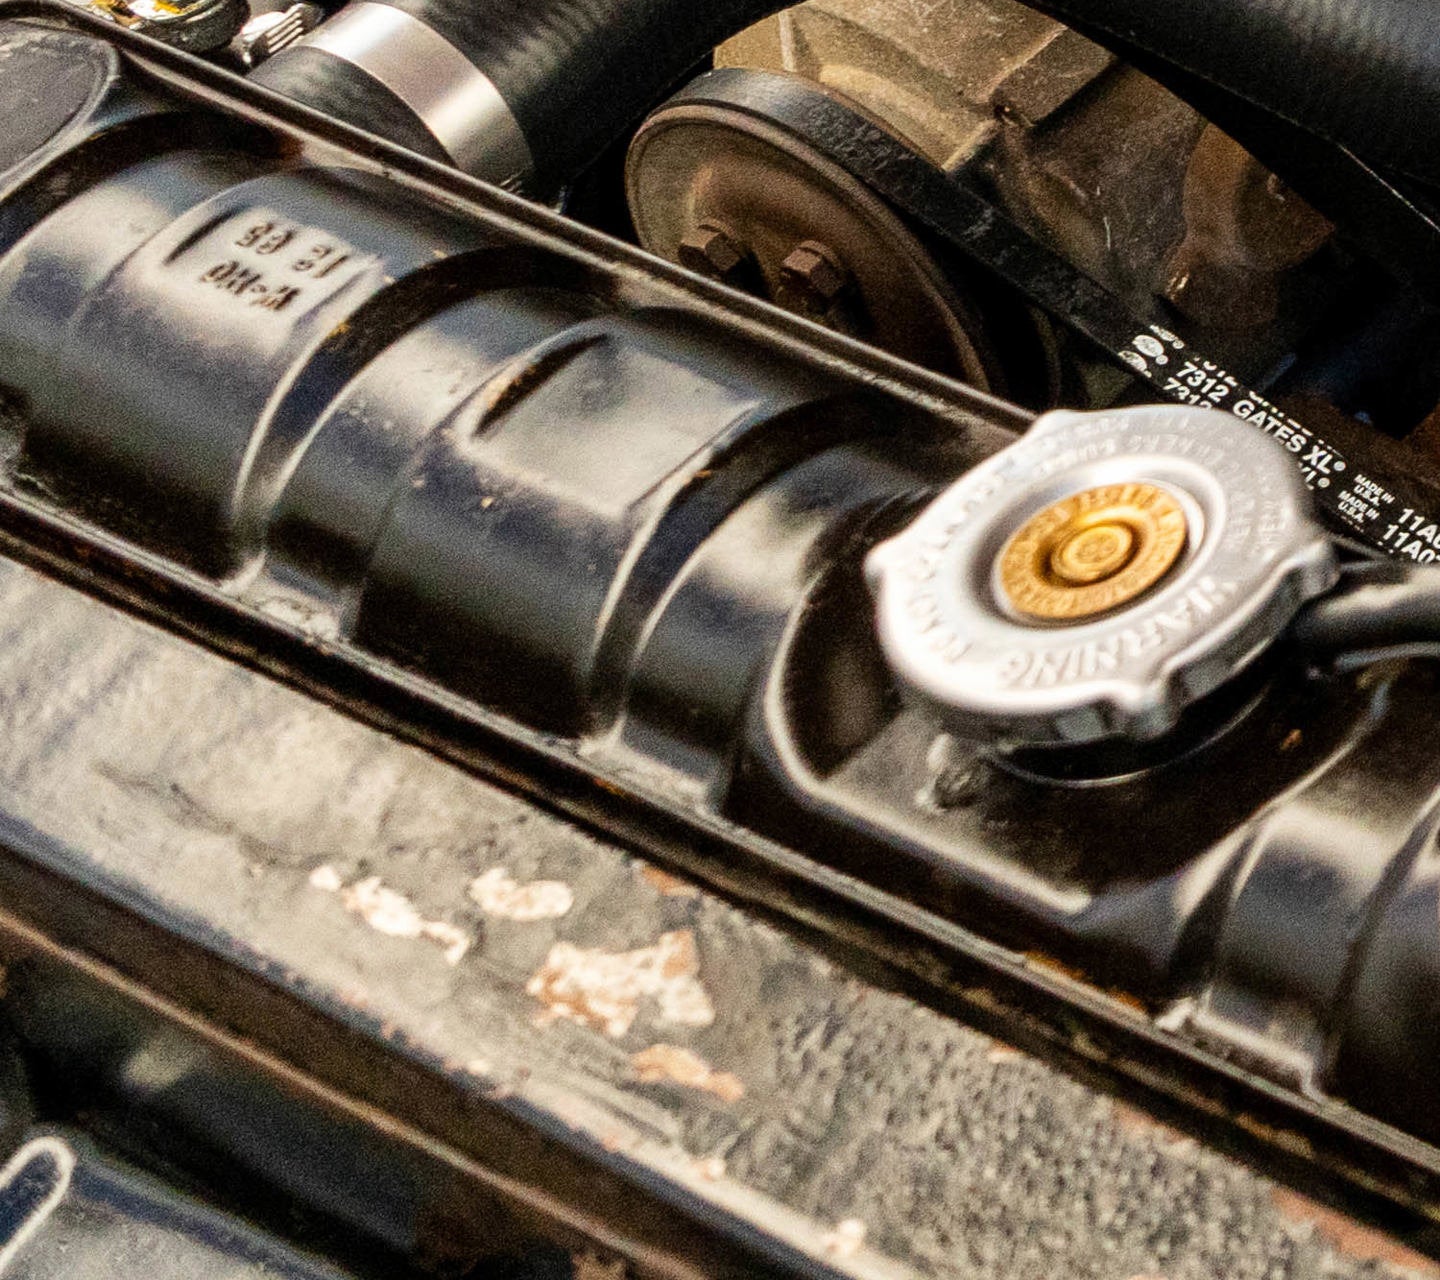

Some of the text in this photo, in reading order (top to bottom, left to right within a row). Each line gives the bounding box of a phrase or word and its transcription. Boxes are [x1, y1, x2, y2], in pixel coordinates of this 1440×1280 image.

[1176, 361, 1230, 403] 7312
[1232, 399, 1307, 454] GATES
[1338, 489, 1381, 521] MADE IN
[1354, 474, 1396, 506] MADE IN
